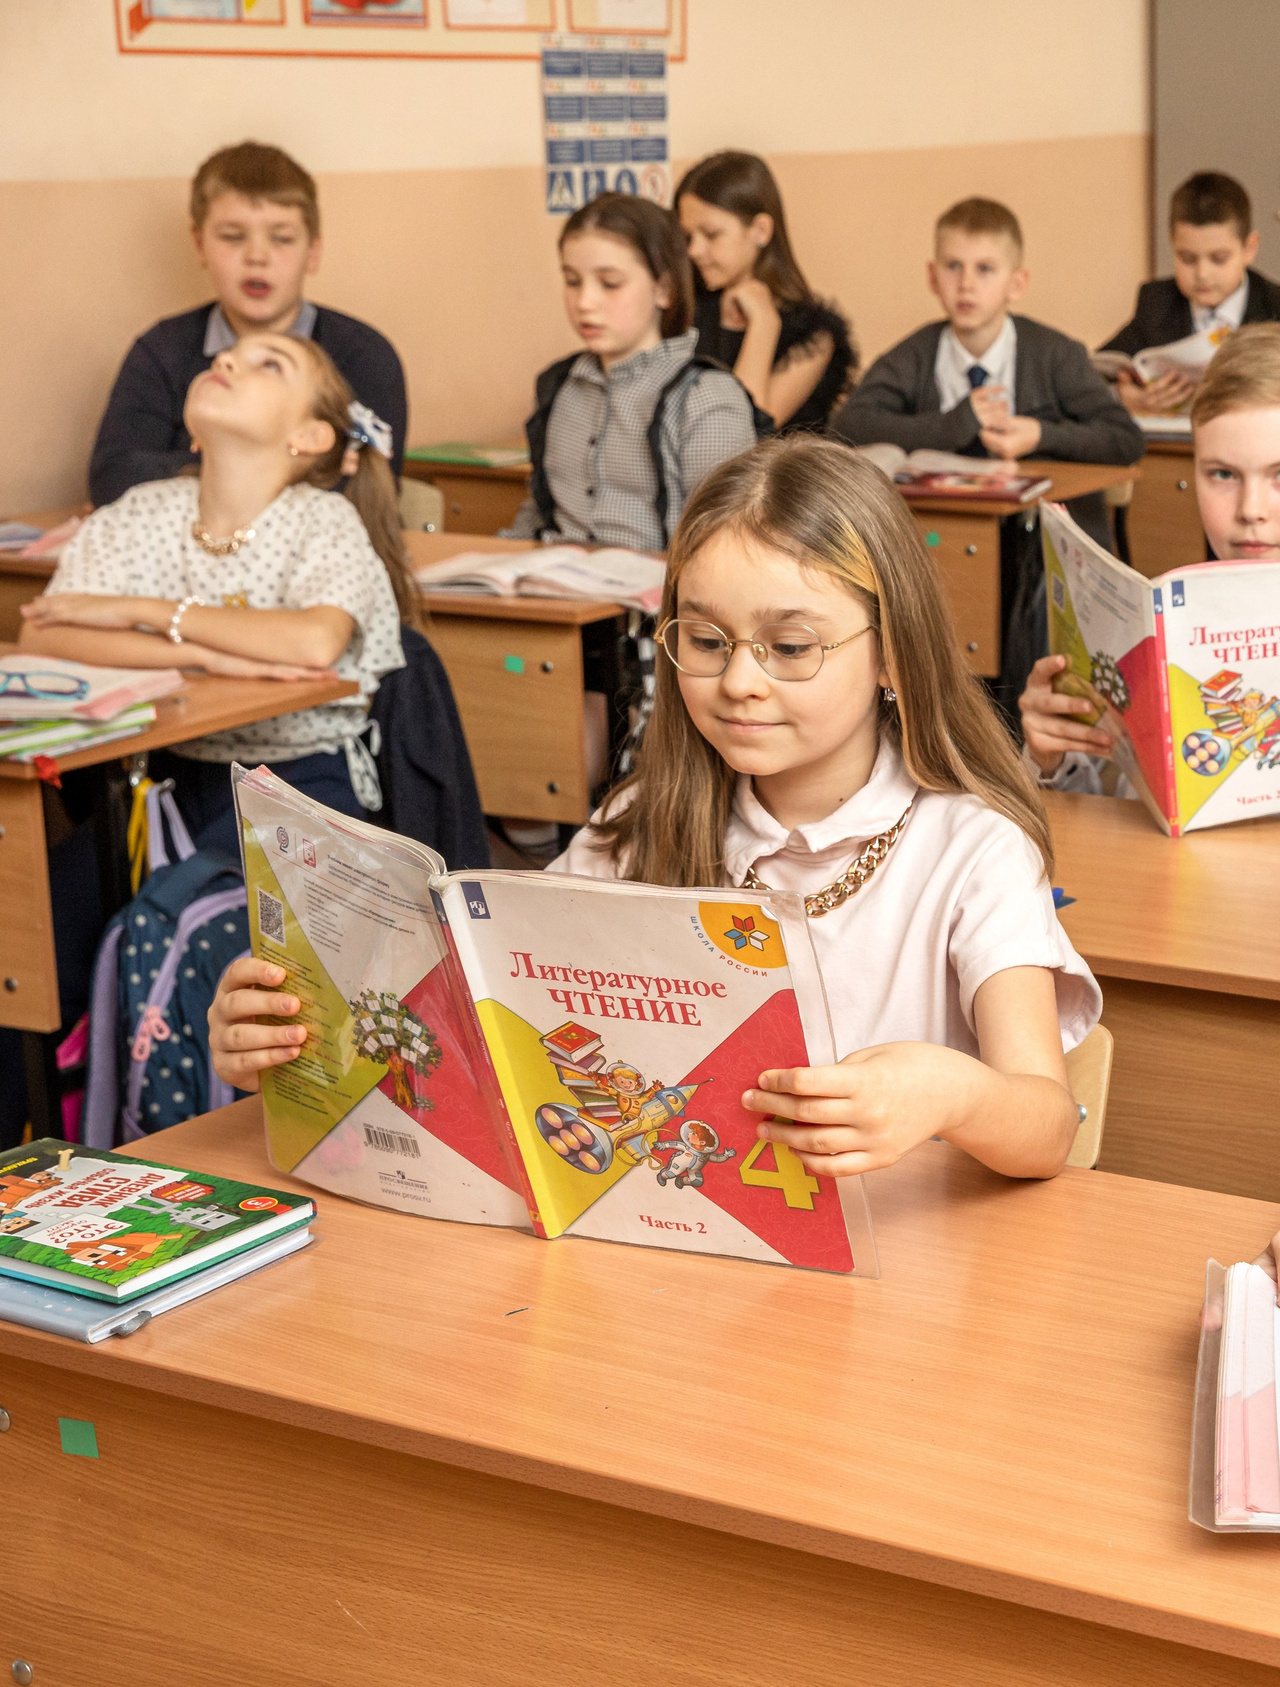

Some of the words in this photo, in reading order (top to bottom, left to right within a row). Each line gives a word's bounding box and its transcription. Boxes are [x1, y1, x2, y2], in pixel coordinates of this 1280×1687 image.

[690, 915, 715, 953] ШКОЛА
[719, 954, 769, 978] РОССИИ
[509, 951, 728, 1000] Литературное
[547, 988, 702, 1027] ЧТЕНИЕ
[739, 1115, 821, 1211] 4
[52, 1176, 131, 1208] СТИВА
[89, 1173, 165, 1208] ДНЕВНИК
[638, 1214, 693, 1233] Часть
[696, 1222, 708, 1234] 2
